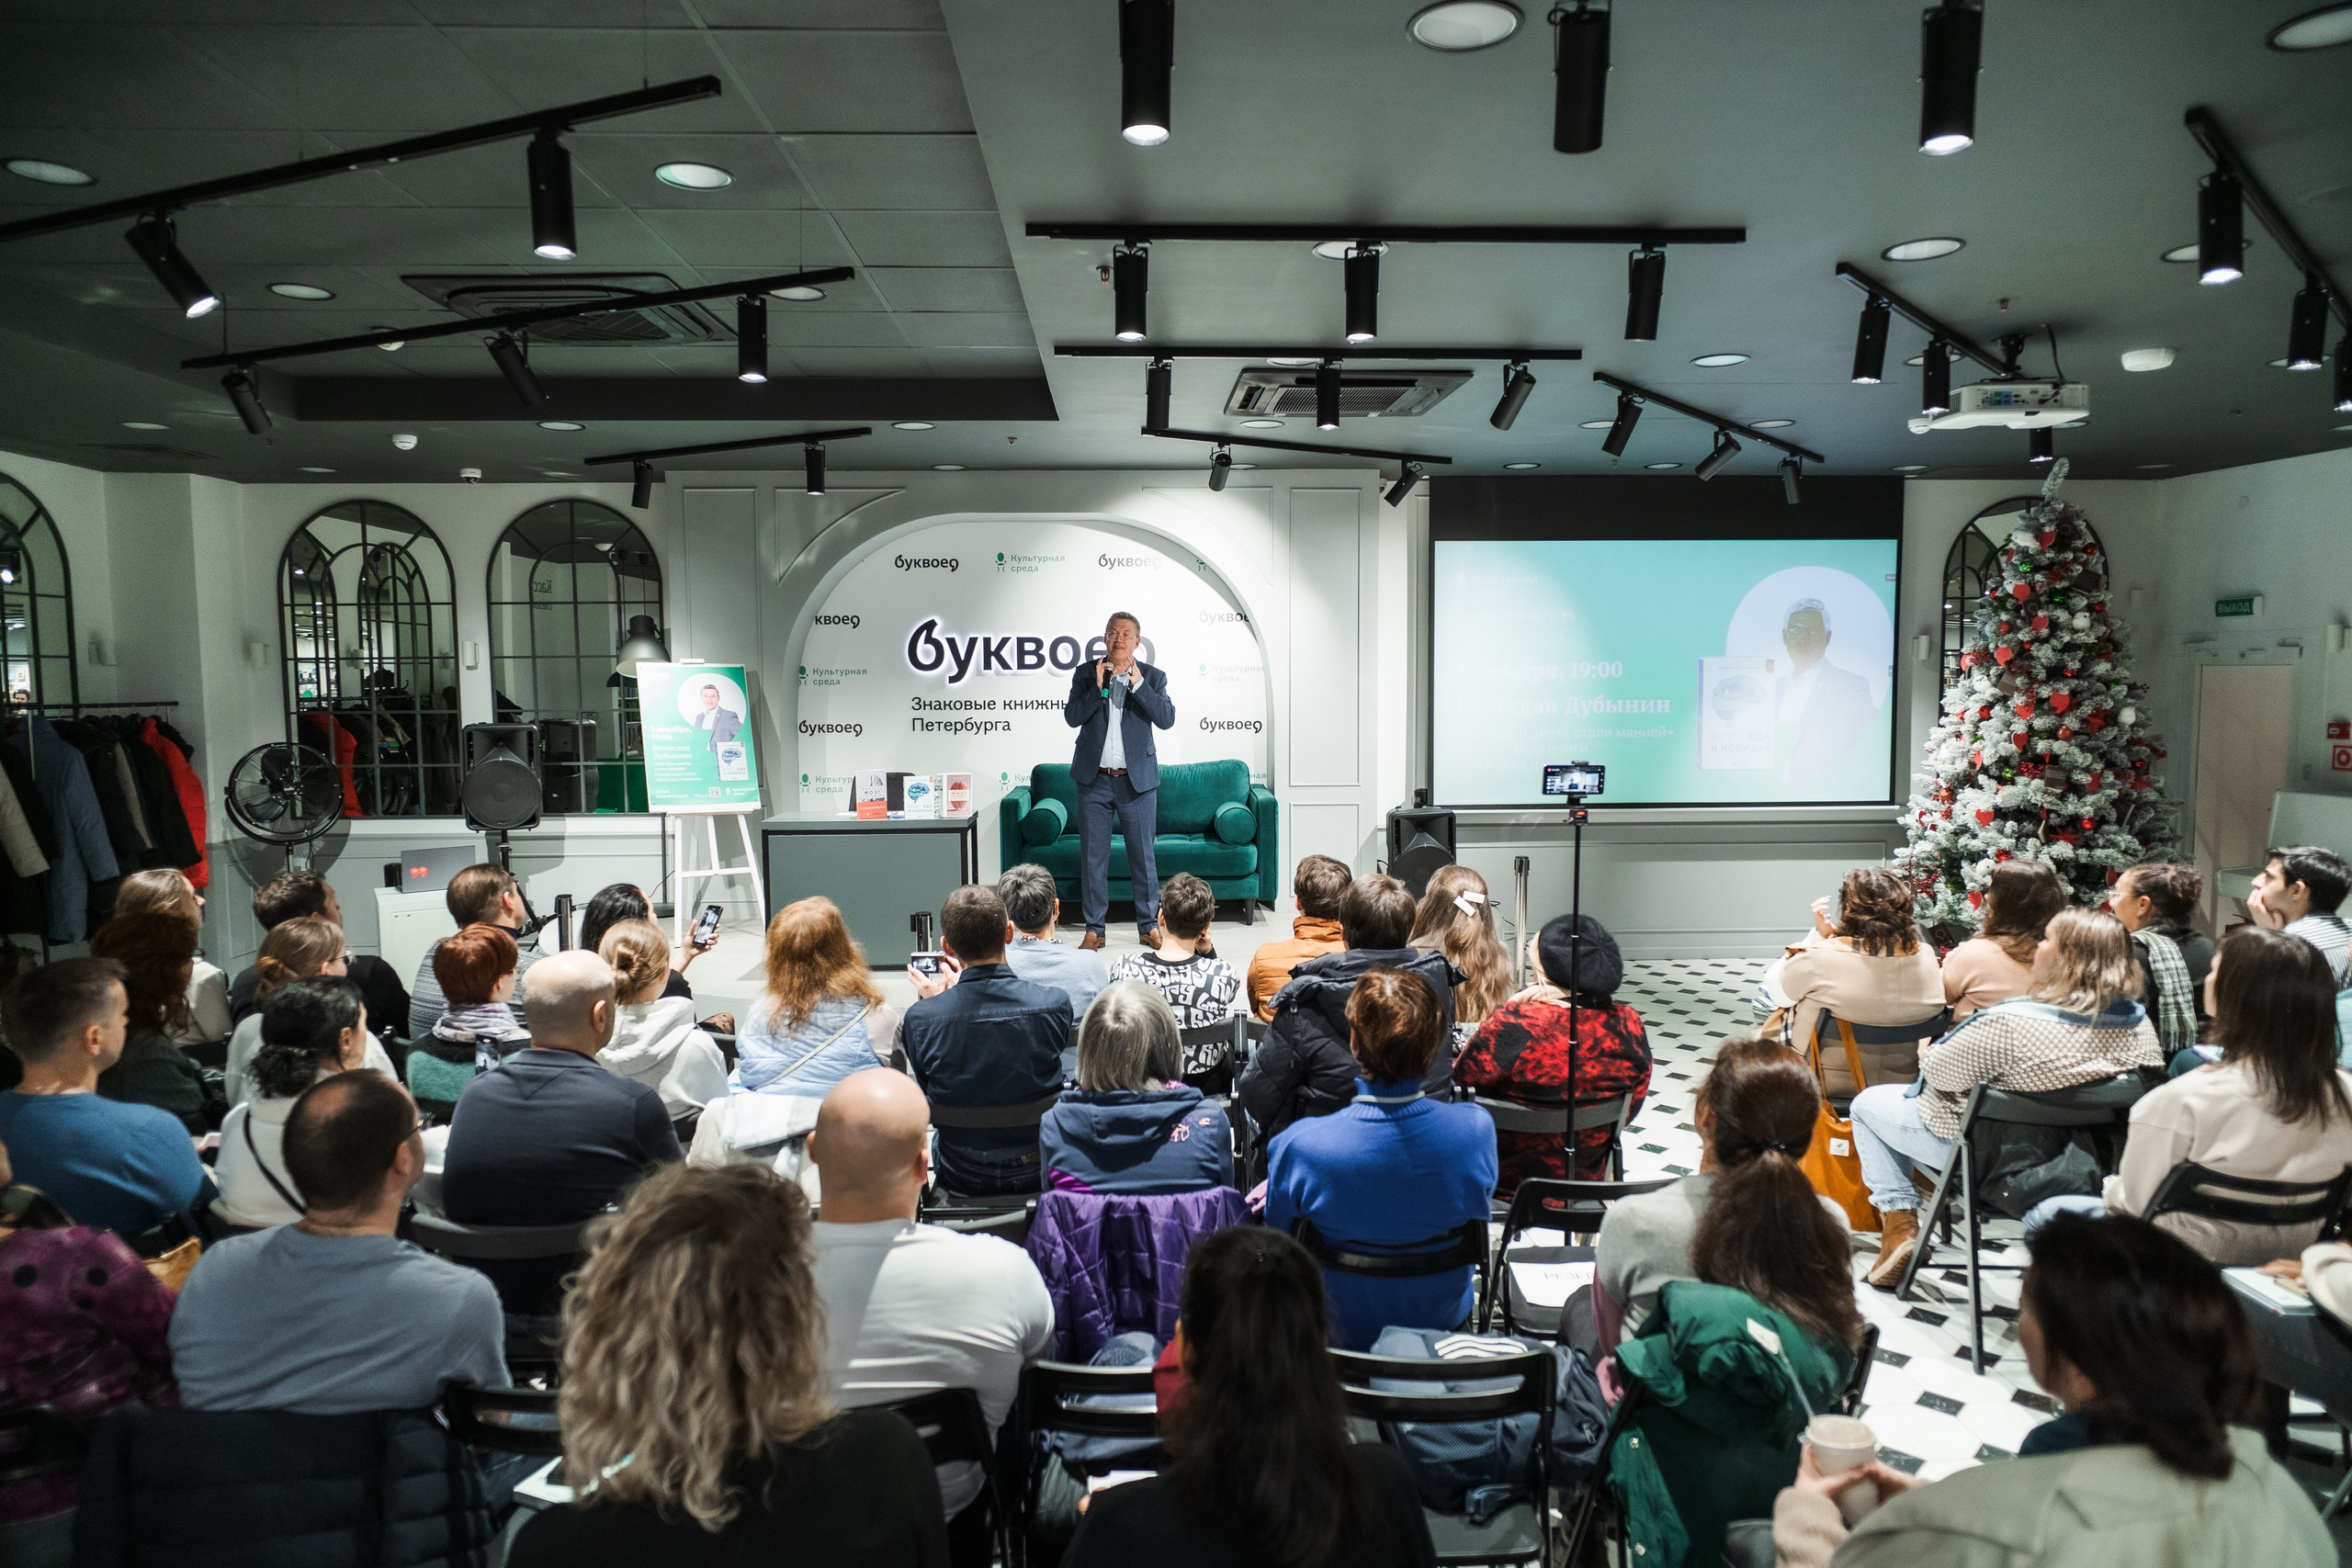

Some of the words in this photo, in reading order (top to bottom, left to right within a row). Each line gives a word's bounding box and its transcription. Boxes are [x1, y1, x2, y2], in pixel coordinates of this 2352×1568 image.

[894, 554, 959, 572] буквоед
[1011, 554, 1066, 562] Культурная
[1098, 553, 1161, 570] буквоед
[1011, 565, 1039, 573] среда
[1561, 609, 1575, 619] 46
[2218, 603, 2251, 613] ВЫХОД
[812, 668, 867, 677] Культурная
[1569, 660, 1623, 678] 19:00
[1213, 675, 1240, 683] среда
[911, 696, 997, 711] Знаковые
[1564, 695, 1672, 717] Дубынин
[798, 720, 863, 737] буквоед
[911, 717, 1012, 735] Петербурга
[1199, 716, 1262, 734] буквоед
[1530, 728, 1569, 739] диета
[1573, 728, 1612, 738] стали
[1615, 726, 1674, 738] манией»
[1548, 744, 1589, 754] книги
[1721, 744, 1770, 752] НОВИЗНА
